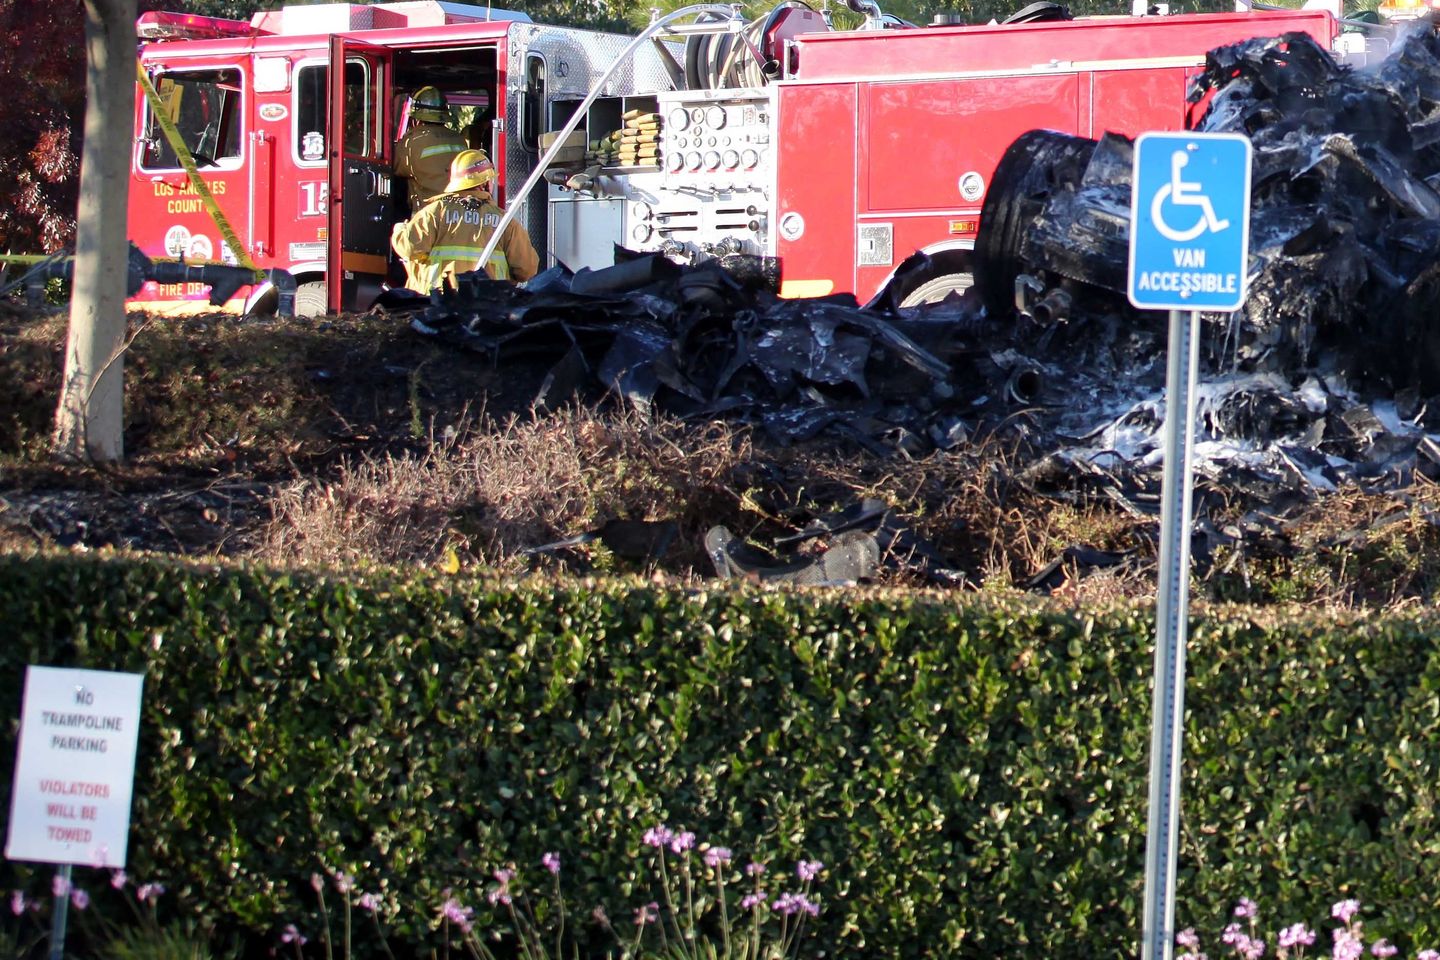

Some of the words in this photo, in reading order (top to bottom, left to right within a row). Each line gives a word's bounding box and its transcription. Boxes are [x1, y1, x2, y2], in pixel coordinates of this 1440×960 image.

[154, 183, 174, 196] LOS
[179, 181, 226, 195] ANES
[167, 199, 211, 214] COUNT
[446, 209, 460, 224] LA
[464, 211, 480, 225] CO
[1173, 248, 1205, 268] VAN
[160, 283, 183, 296] FIRE
[1138, 271, 1237, 293] ACCESSIBLE
[76, 691, 94, 706] NO
[42, 712, 123, 731] TRAMPOLINE
[52, 736, 107, 753] PARKING
[39, 779, 110, 798] VIOLATORS
[47, 803, 76, 820] WILL
[81, 806, 97, 820] BE
[47, 826, 92, 843] TOWED
